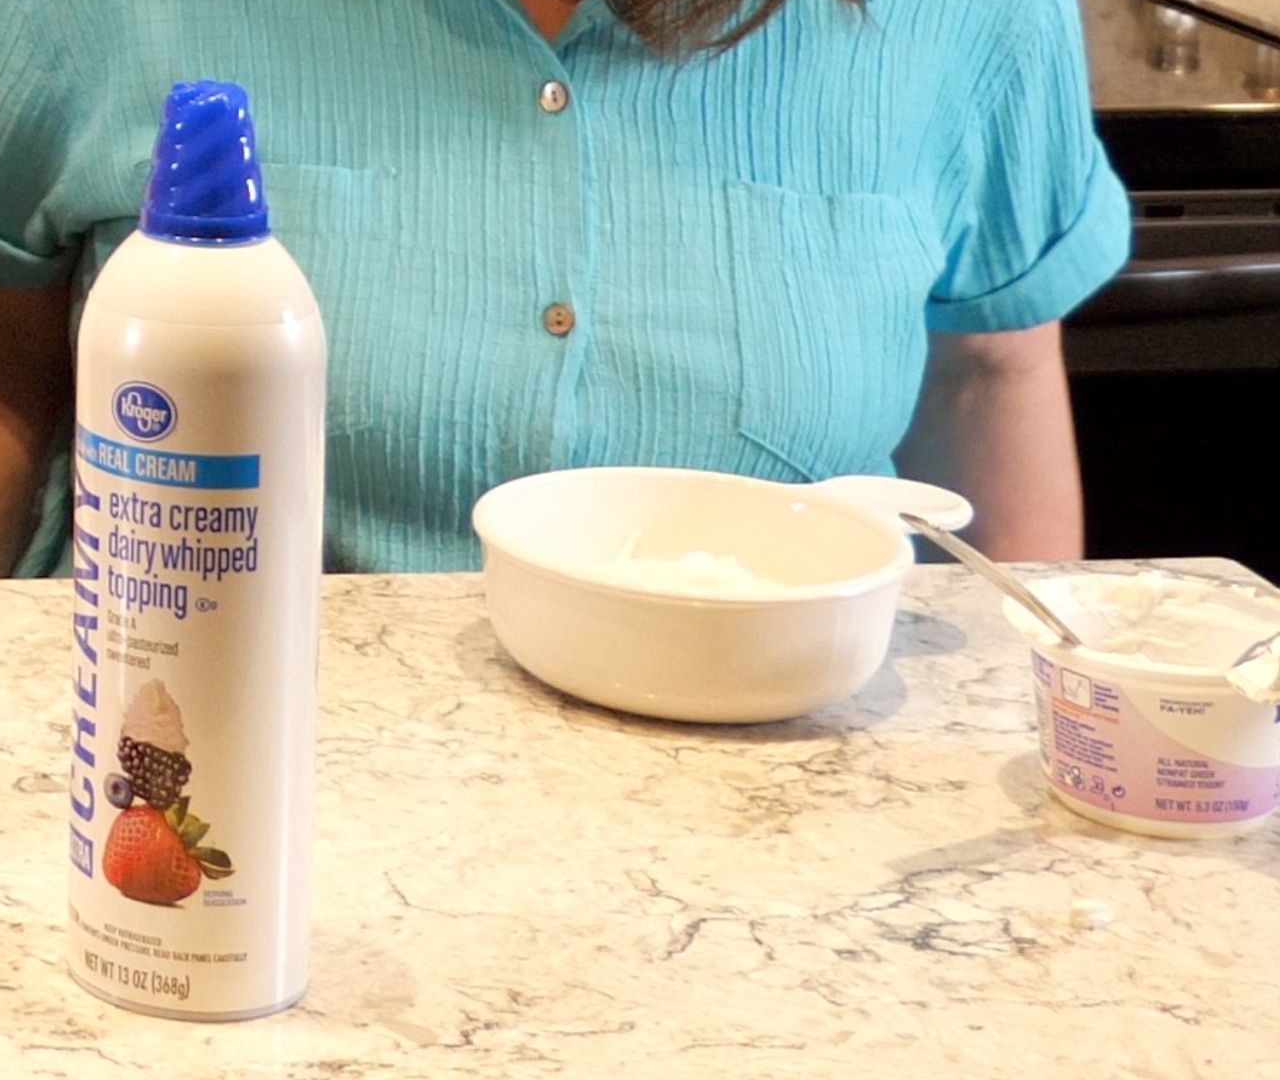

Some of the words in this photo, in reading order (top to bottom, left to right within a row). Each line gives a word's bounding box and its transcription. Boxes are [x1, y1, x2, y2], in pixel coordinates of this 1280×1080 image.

[121, 391, 168, 432] Kroger
[99, 443, 131, 473] REAL
[135, 452, 198, 483] CREAM
[109, 492, 162, 528] extra
[169, 504, 259, 541] creamy
[108, 525, 156, 575] dairy
[161, 537, 258, 582] whipped
[108, 566, 188, 620] topping
[72, 472, 101, 821] CREAMY
[1155, 798, 1174, 810] NET
[85, 950, 98, 974] NET
[101, 955, 115, 980] WT
[117, 964, 130, 986] 13
[132, 968, 149, 990] OZ
[151, 970, 190, 1001] (368g)
